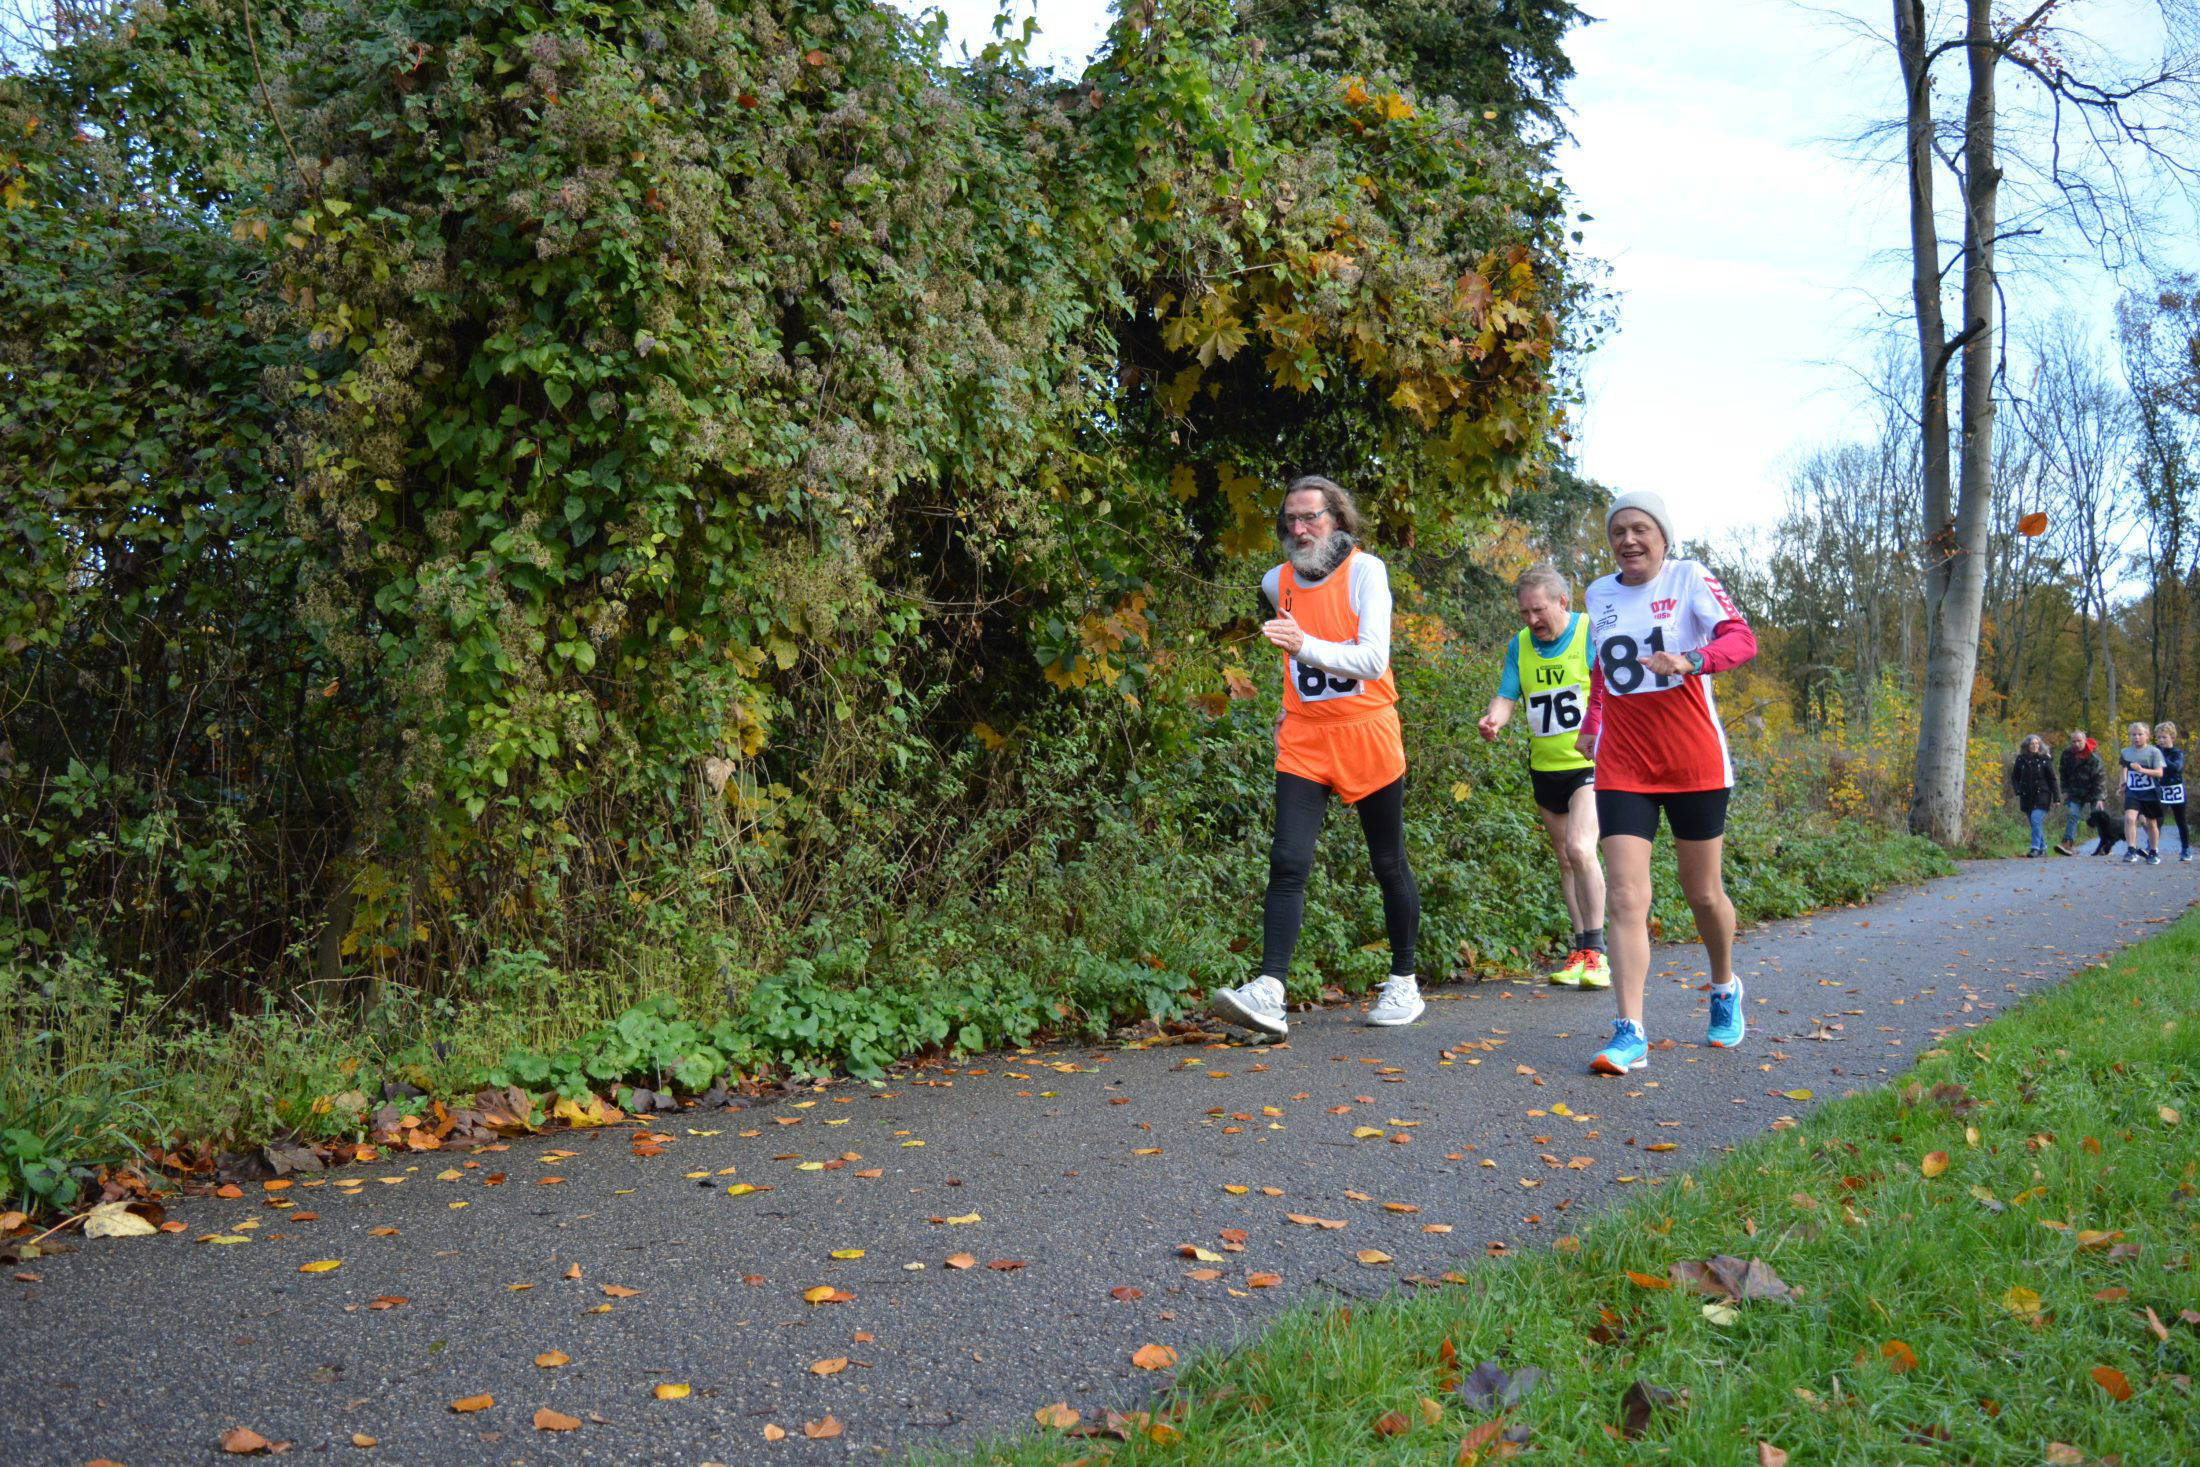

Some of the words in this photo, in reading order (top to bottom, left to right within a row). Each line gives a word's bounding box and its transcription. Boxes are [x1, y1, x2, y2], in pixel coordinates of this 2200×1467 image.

[1600, 626, 1669, 694] 81
[1529, 690, 1582, 734] 76
[2130, 773, 2152, 788] 123
